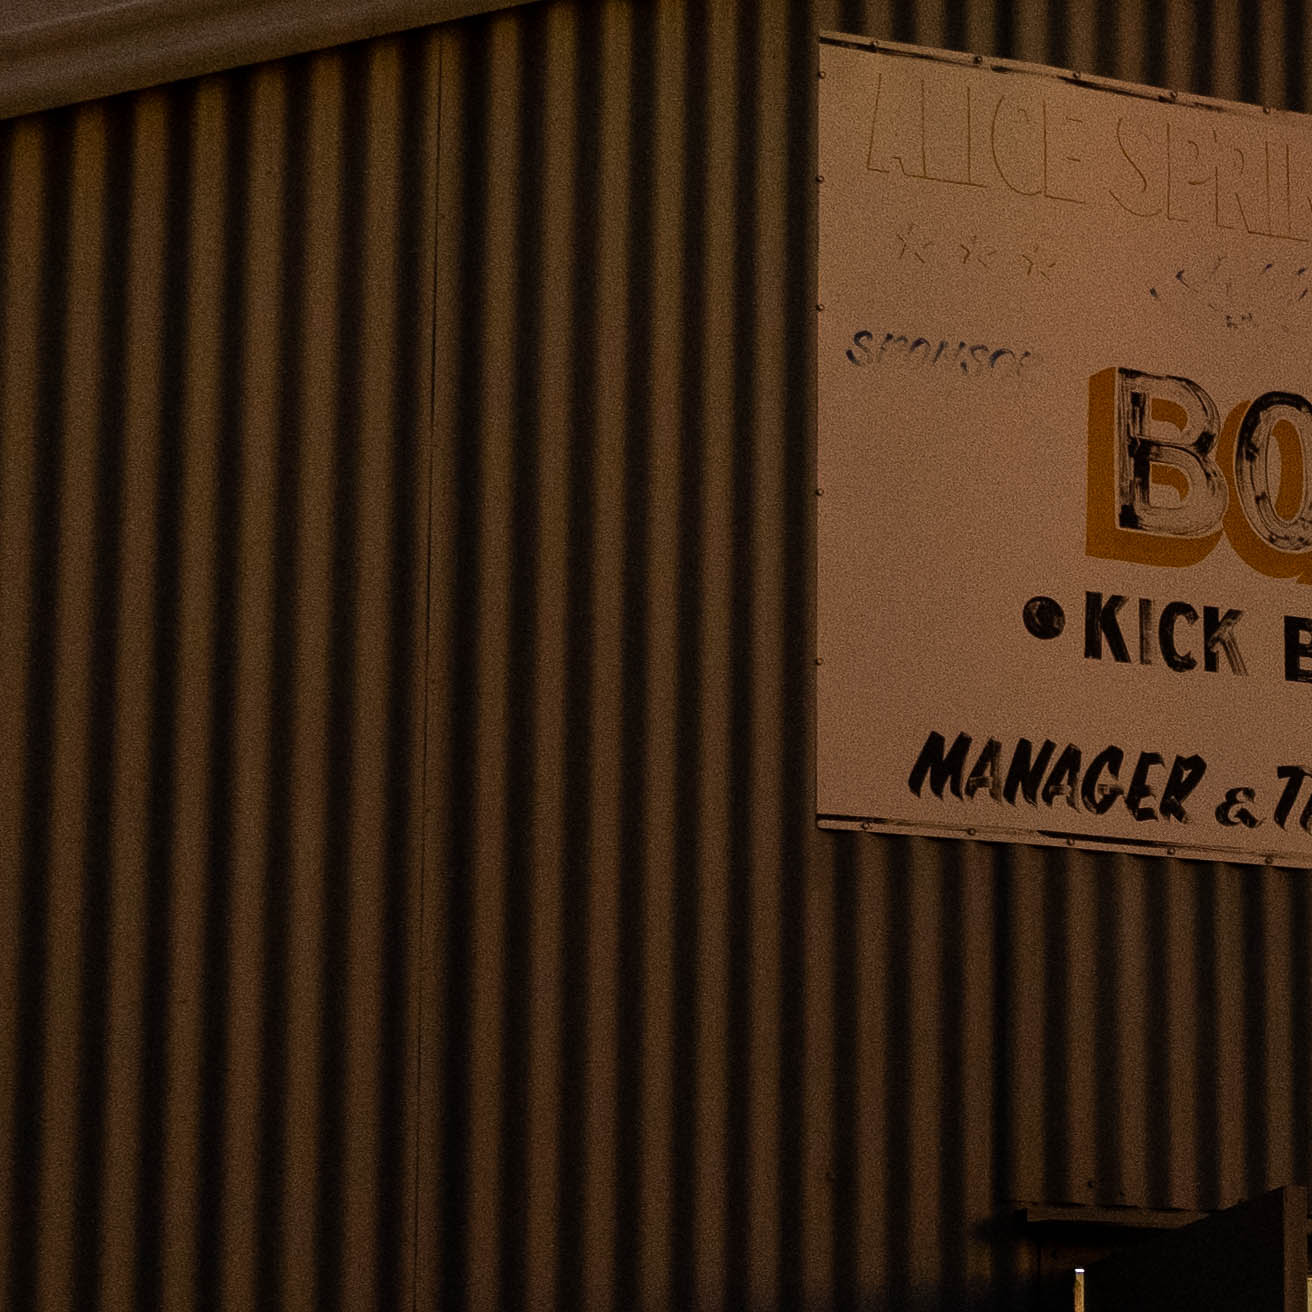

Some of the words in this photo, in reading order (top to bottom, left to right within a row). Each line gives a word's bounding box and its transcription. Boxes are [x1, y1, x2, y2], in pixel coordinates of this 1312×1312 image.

[1082, 589, 1250, 677] KICK
[906, 729, 1209, 824] MANAGER
[1215, 785, 1263, 830] &
